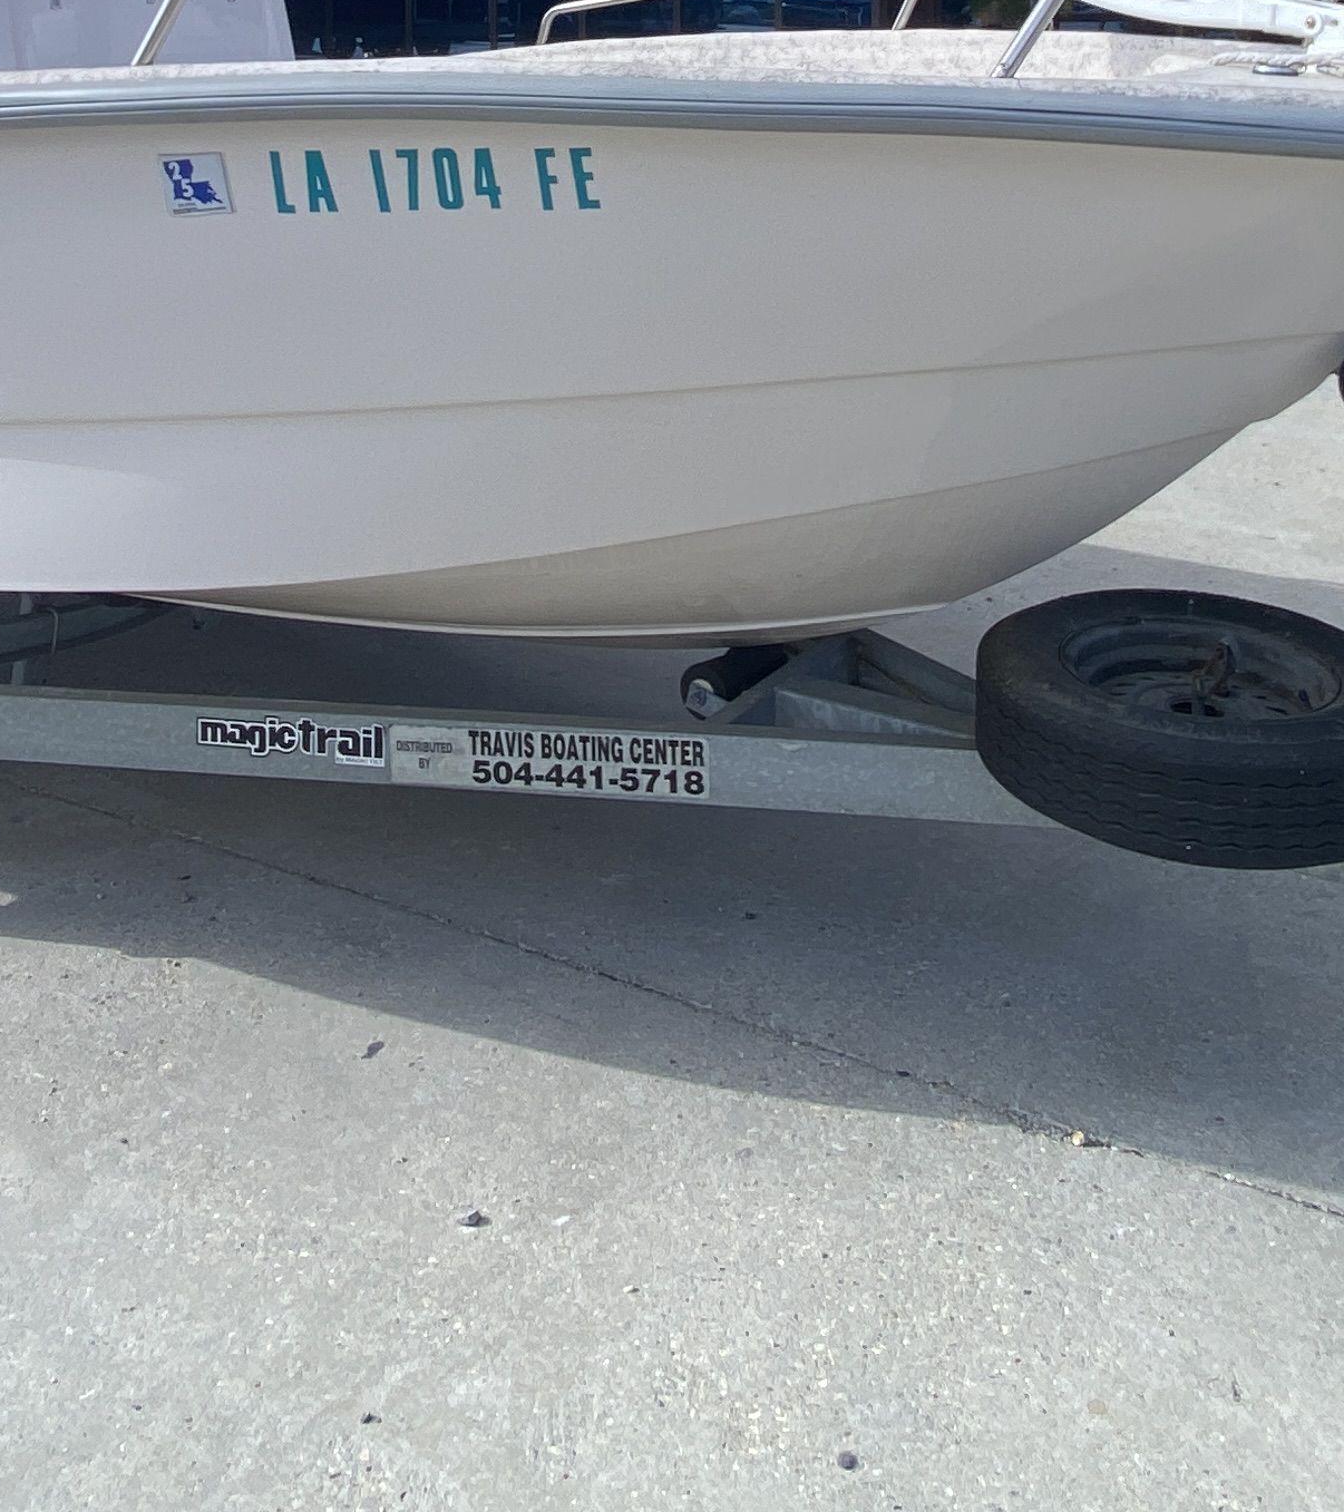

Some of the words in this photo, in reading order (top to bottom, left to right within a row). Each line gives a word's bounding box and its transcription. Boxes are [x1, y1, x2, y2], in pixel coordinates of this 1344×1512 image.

[269, 149, 339, 214] LA
[368, 147, 502, 213] 1704
[534, 147, 601, 211] FE
[396, 740, 453, 754] DISTRIBUTED
[418, 757, 431, 769] BY
[468, 730, 535, 759] TRAVIS
[540, 733, 624, 763] BOATING
[629, 737, 705, 767] CENTER
[472, 759, 705, 796] 504-441-5718
